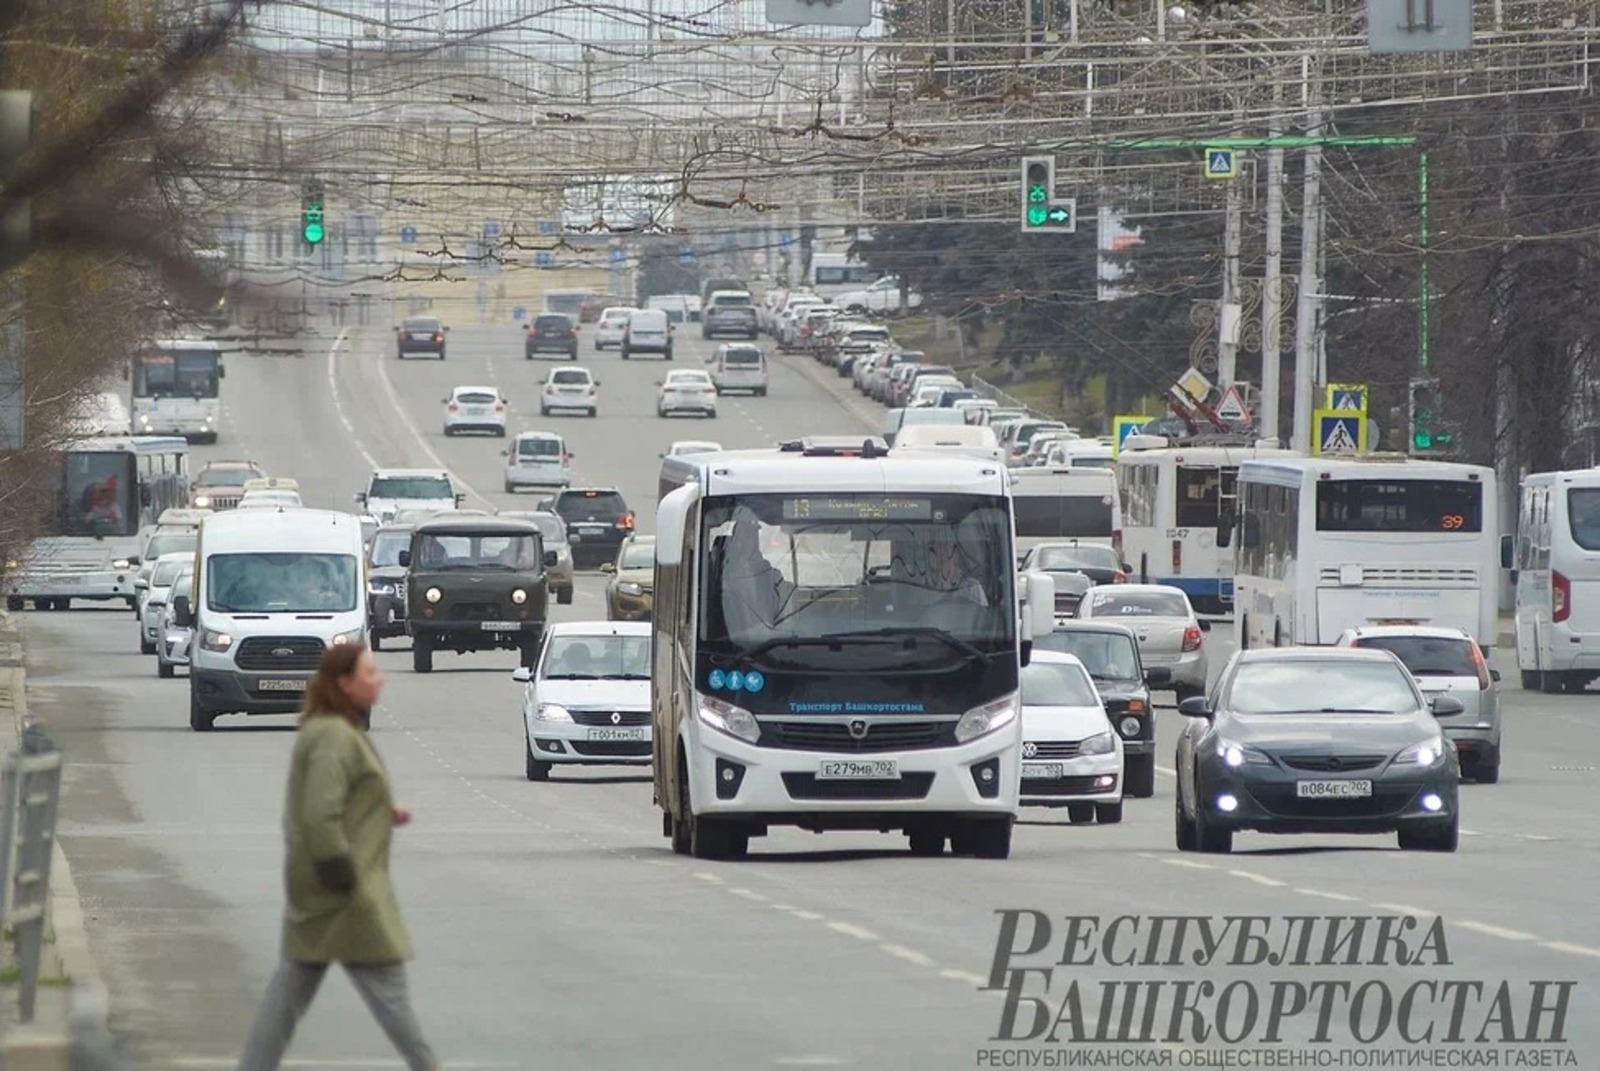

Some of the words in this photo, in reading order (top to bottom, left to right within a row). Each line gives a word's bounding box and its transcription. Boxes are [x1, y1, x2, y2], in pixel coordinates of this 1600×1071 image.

[1442, 514, 1463, 528] 39
[789, 702, 843, 712] Транспорт
[845, 702, 924, 712] Башкортостана
[825, 763, 873, 776] Е279МВ
[875, 761, 893, 772] 702
[1301, 782, 1348, 796] В084ЕС
[1350, 781, 1369, 791] 702
